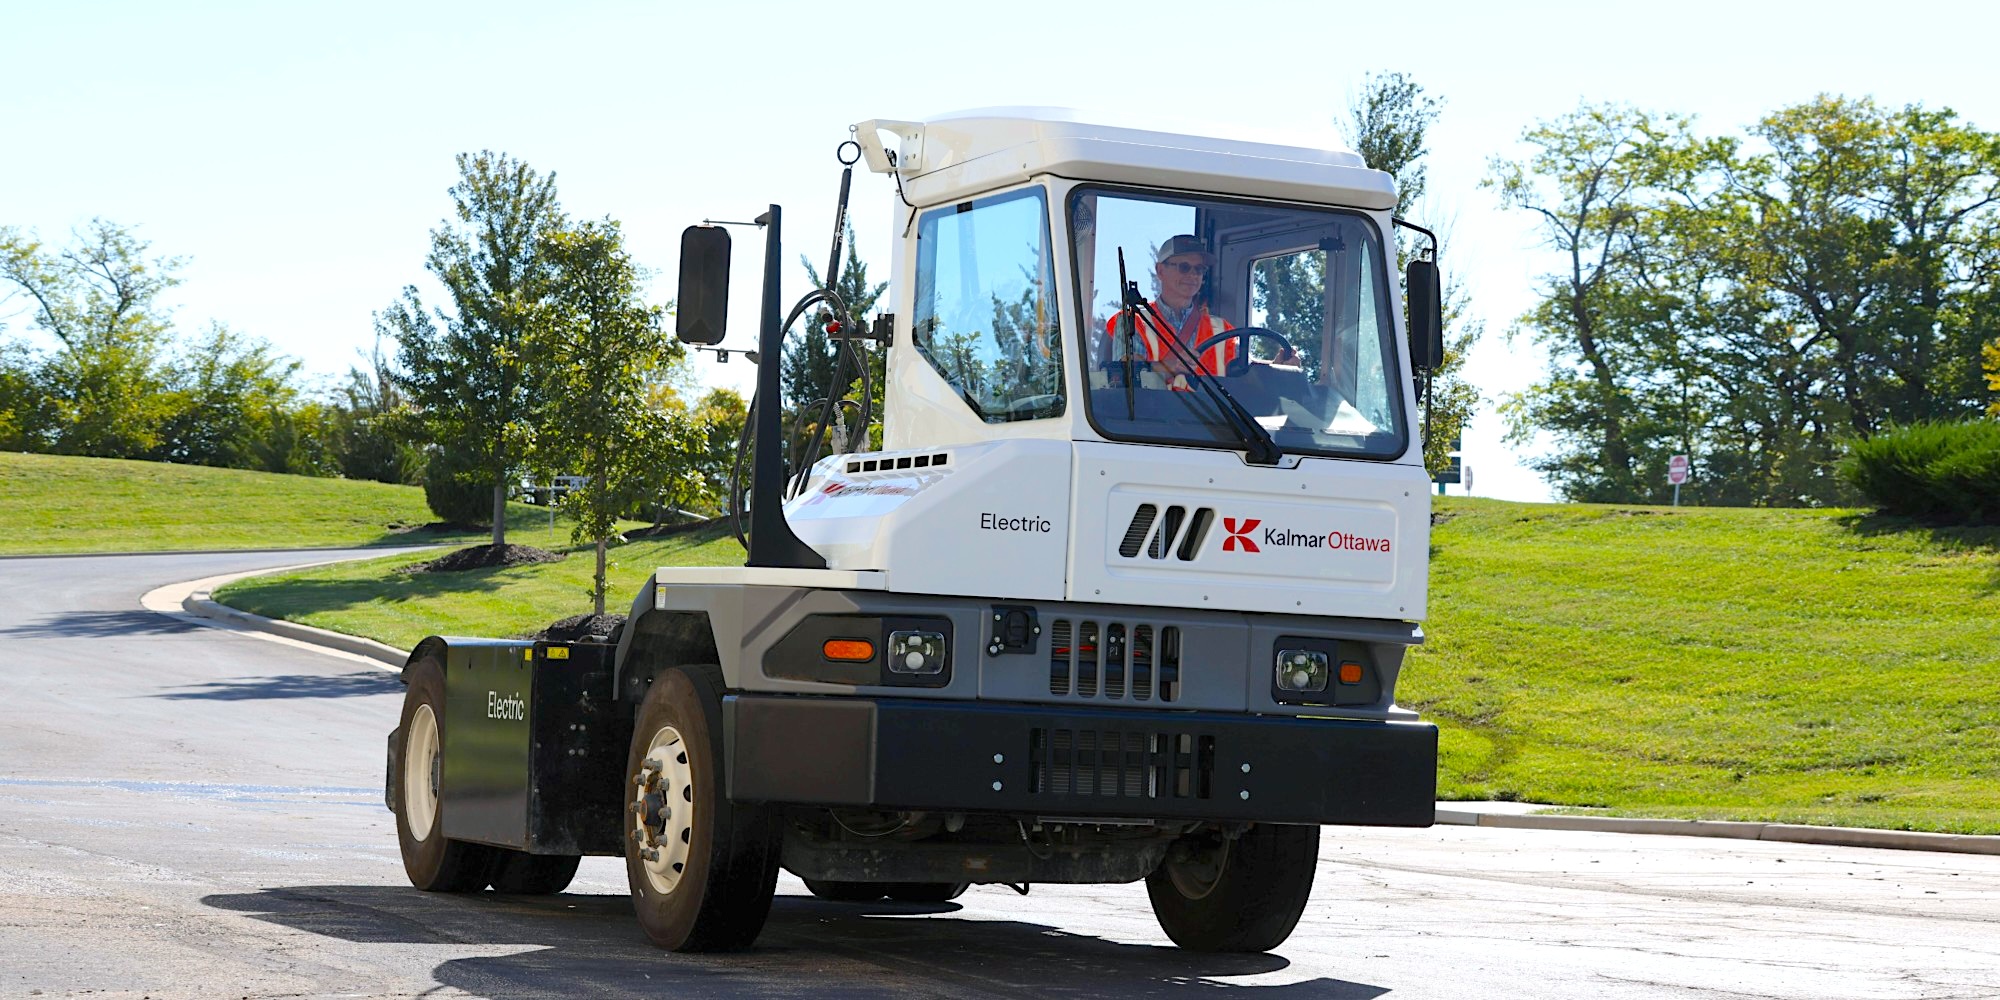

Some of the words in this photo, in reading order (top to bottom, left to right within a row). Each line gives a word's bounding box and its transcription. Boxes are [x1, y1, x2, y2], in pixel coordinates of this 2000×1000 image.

[981, 513, 1051, 532] Electric
[1264, 528, 1325, 548] Kalmar
[1328, 532, 1390, 552] Ottawa
[488, 691, 524, 720] Electric
